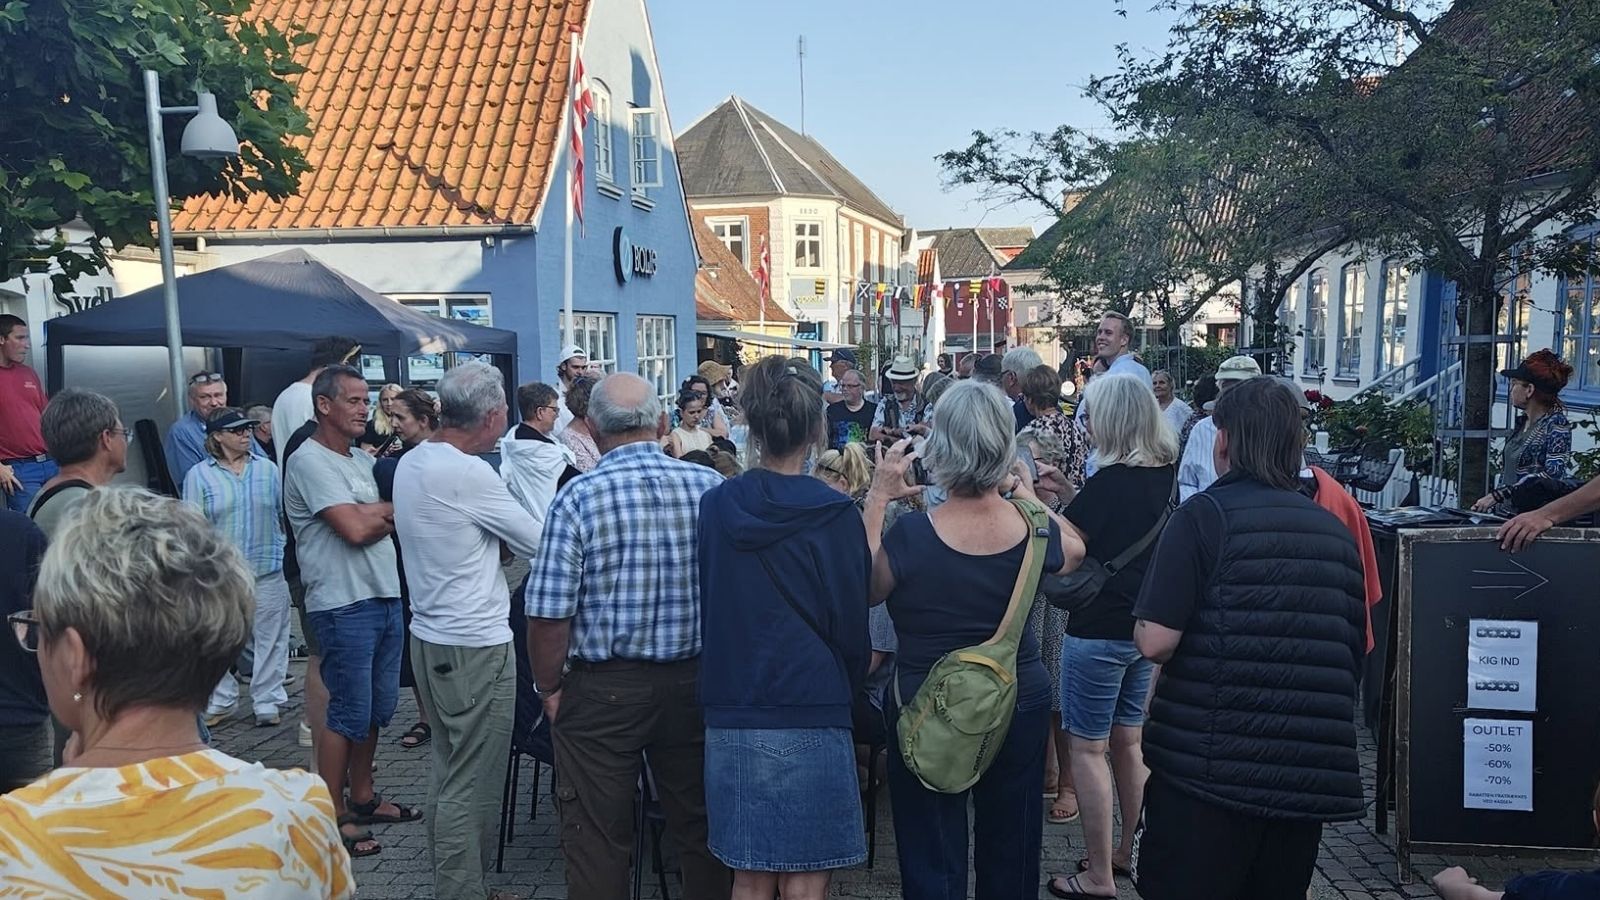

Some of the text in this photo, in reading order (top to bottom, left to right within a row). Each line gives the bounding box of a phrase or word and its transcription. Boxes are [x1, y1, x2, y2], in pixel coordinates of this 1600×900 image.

[1479, 656, 1520, 666] KIG IND
[1472, 725, 1523, 736] OUTLET
[1484, 743, 1512, 753] -50%
[1484, 759, 1512, 769] -60%
[1484, 776, 1512, 785] -70%
